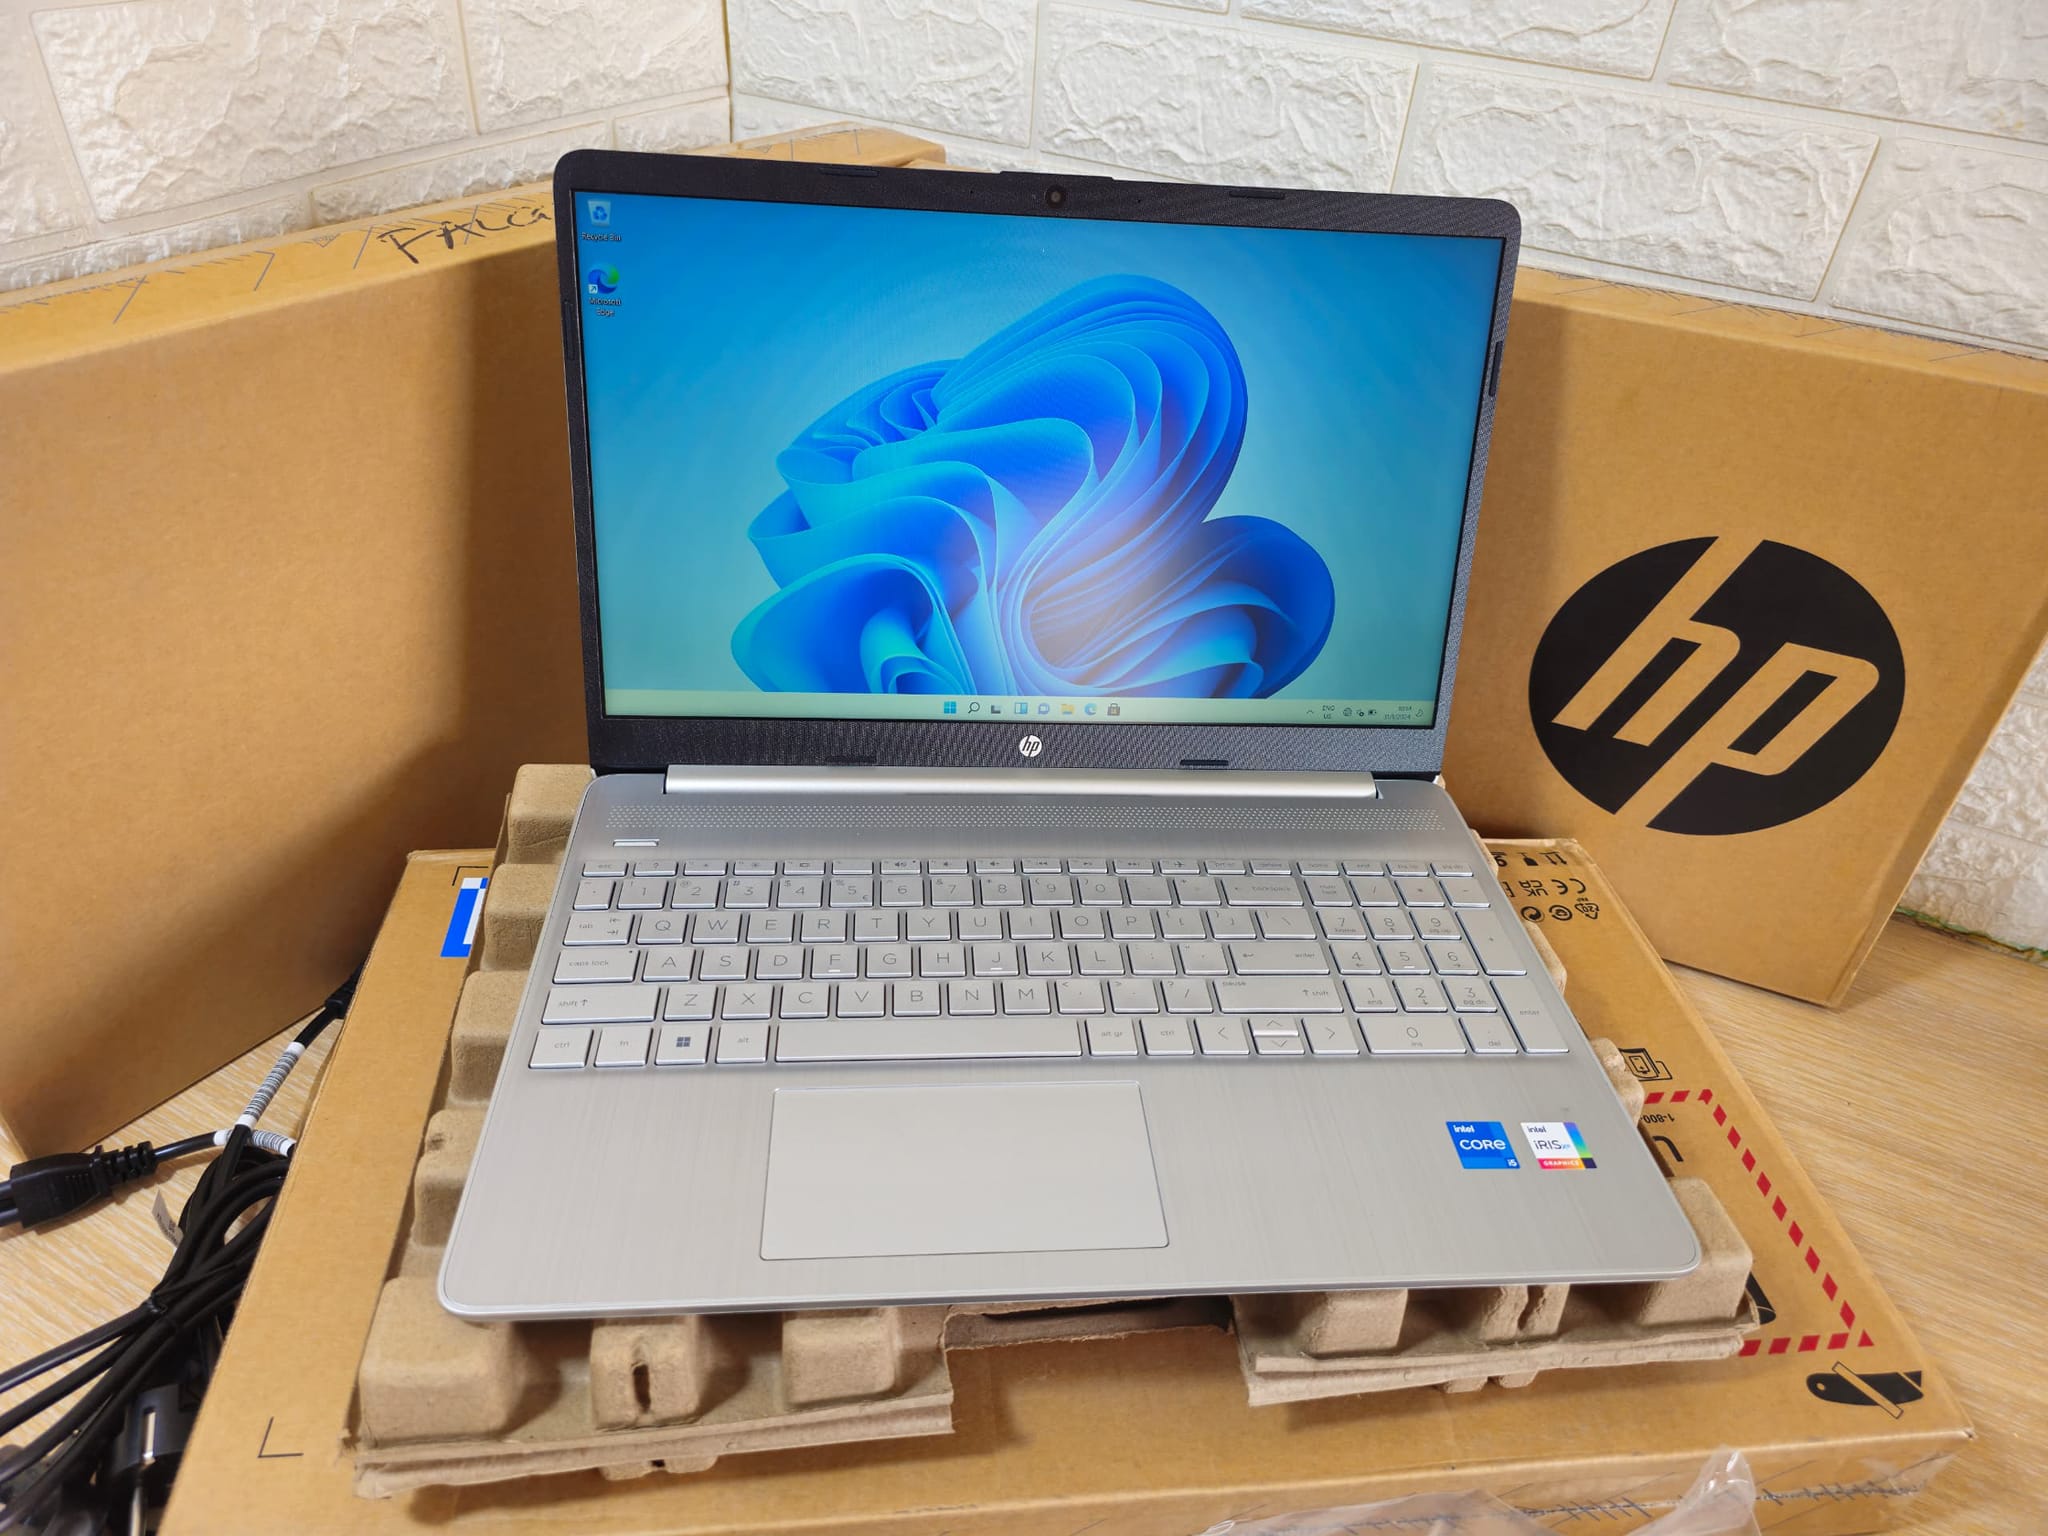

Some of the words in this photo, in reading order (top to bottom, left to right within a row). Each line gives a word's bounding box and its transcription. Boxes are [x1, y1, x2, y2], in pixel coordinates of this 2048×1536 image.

[1540, 536, 1888, 831] hp
[1020, 735, 1042, 757] hp
[655, 919, 671, 932] Q
[707, 919, 729, 931] W
[765, 919, 778, 931] E
[817, 918, 831, 929] R
[871, 918, 883, 929] T
[923, 917, 935, 928] Y
[973, 916, 987, 927] U
[1074, 916, 1089, 927] O
[1126, 916, 1137, 926] P
[1338, 918, 1345, 927] 7
[1384, 918, 1395, 928] 8
[1430, 918, 1441, 928] 9
[720, 956, 732, 967] S
[774, 955, 788, 966] D
[830, 954, 841, 965] F
[883, 953, 897, 965] G
[936, 953, 950, 964] H
[992, 952, 1001, 963] J
[1042, 952, 1055, 962] K
[1094, 951, 1106, 962] L
[1351, 951, 1362, 961] 4
[1399, 951, 1410, 962] 5
[1447, 951, 1458, 962] 6
[661, 956, 676, 968] A
[798, 992, 813, 1004] C
[854, 991, 869, 1003] V
[911, 990, 924, 1002] B
[965, 989, 980, 1001] N
[1018, 988, 1034, 1000] M
[1415, 988, 1427, 998] 2
[1464, 987, 1476, 998] 3
[684, 993, 698, 1006] Z
[742, 993, 756, 1005] X
[1453, 1124, 1475, 1133] intel
[1507, 1158, 1518, 1167] i5
